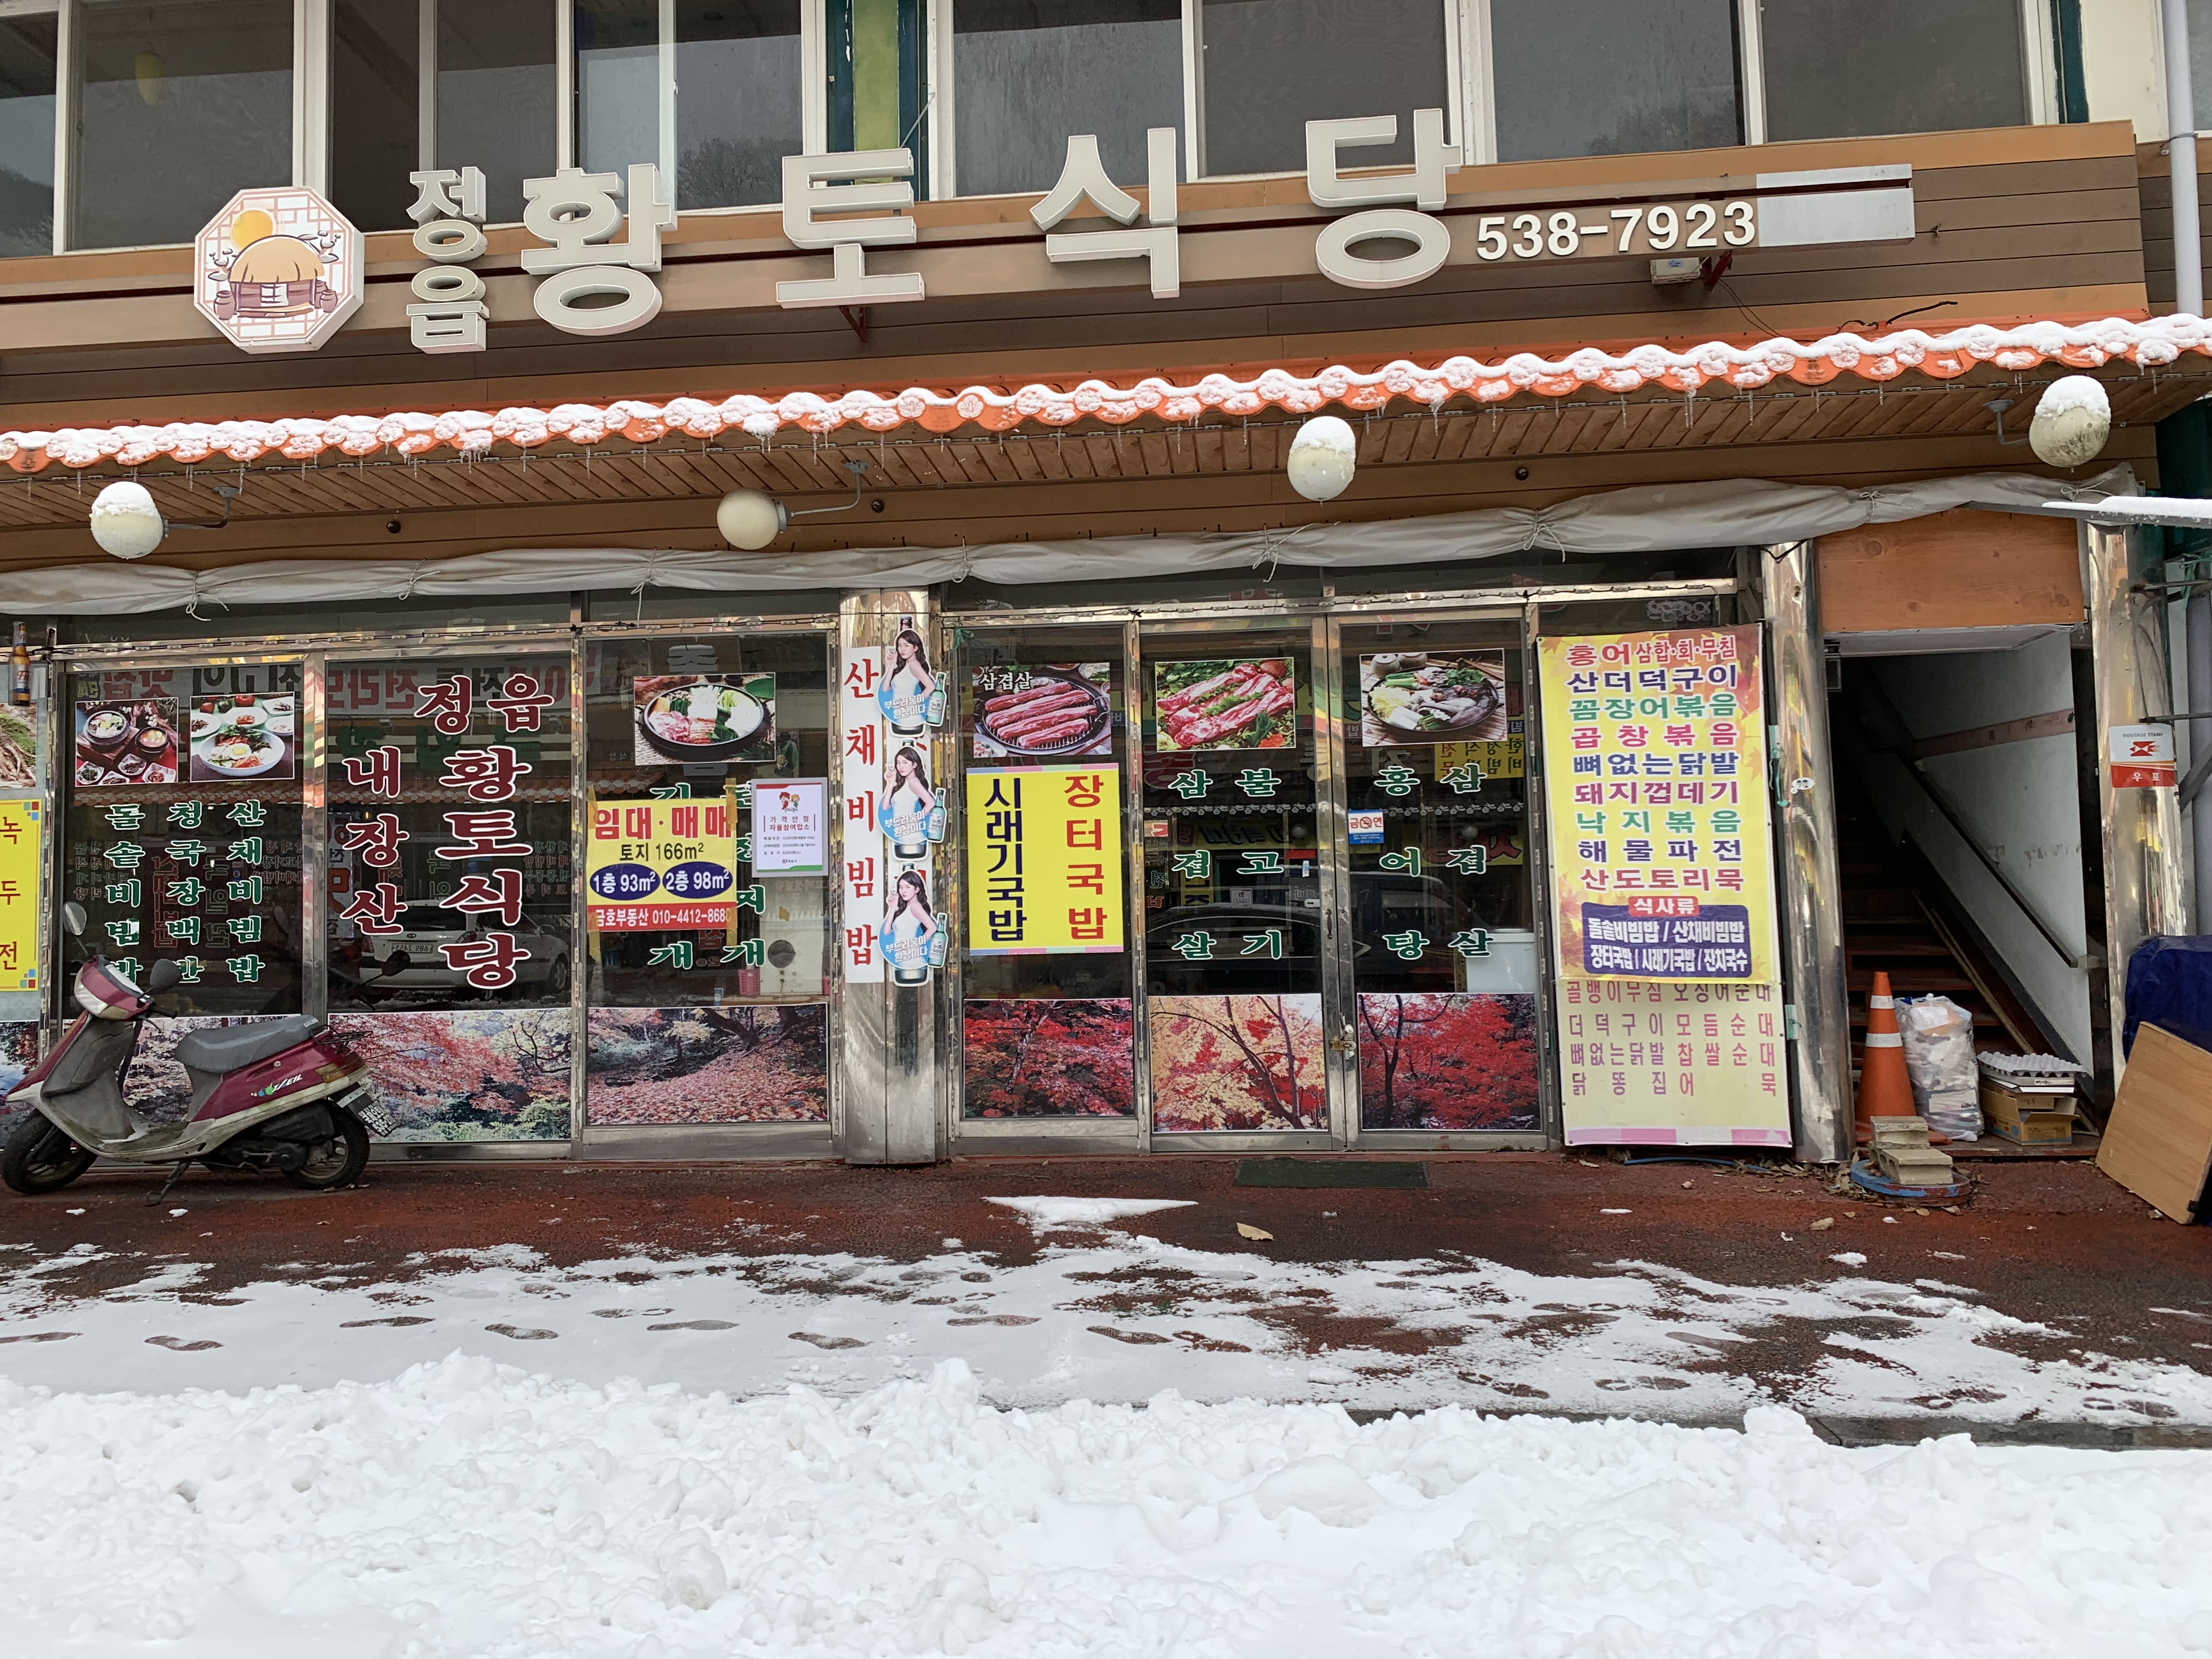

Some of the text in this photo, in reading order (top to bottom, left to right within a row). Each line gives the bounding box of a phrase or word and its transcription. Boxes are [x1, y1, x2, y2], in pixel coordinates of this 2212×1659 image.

[406, 108, 1757, 353] 정읍 황토식당 538-7923
[1568, 644, 1630, 666] 홍어
[979, 672, 1034, 691] 삼겹살
[1567, 664, 1736, 693] 산더덕구이
[415, 674, 555, 735] 정읍
[884, 693, 925, 710] 부드러움이
[893, 704, 926, 720] 환상이다
[1569, 693, 1737, 721] 꼼장어볶음
[1571, 723, 1738, 749] 곱창볶음
[1573, 752, 1739, 776] 뼈없는닭발
[1575, 781, 1738, 805] 돼지껍데기
[844, 658, 879, 966] 산채비빔밥
[884, 810, 925, 828] 부드러움이
[1350, 817, 1382, 828] 금연
[1577, 810, 1741, 833] 낙지볶음
[340, 746, 409, 935] 내장산
[894, 821, 927, 838] 환상이다
[619, 843, 649, 861] 토지
[984, 777, 1027, 943] 시래기국밥
[1064, 775, 1107, 940] 장터국밥
[1374, 765, 1429, 960] 홍어탕
[1440, 763, 1495, 958] 삼겹살
[1578, 839, 1742, 862] 해물파전
[435, 746, 533, 990] 황토식당
[1167, 769, 1216, 960] 삼겹살
[1235, 768, 1284, 960] 불고기
[225, 799, 266, 983] 산채비빔밥
[593, 873, 617, 894] 1층
[665, 871, 689, 891] 2층
[1580, 868, 1744, 891] 산도토리묵
[595, 909, 648, 927] 금호부동산
[1634, 898, 1695, 915] 식사류
[1588, 917, 1660, 943] 돌솥비빔밥
[1672, 921, 1745, 943] 산채비빔밥
[885, 935, 927, 953] 부드러움이
[894, 945, 928, 963] 환상이다
[1590, 945, 1634, 970] 장터국밥
[1641, 949, 1696, 972] 시래기국밥
[1703, 949, 1748, 972] 잔치국수
[1569, 1013, 1774, 1037] 더덕구이 모듬순대
[1678, 1043, 1775, 1068] 찹쌀순대
